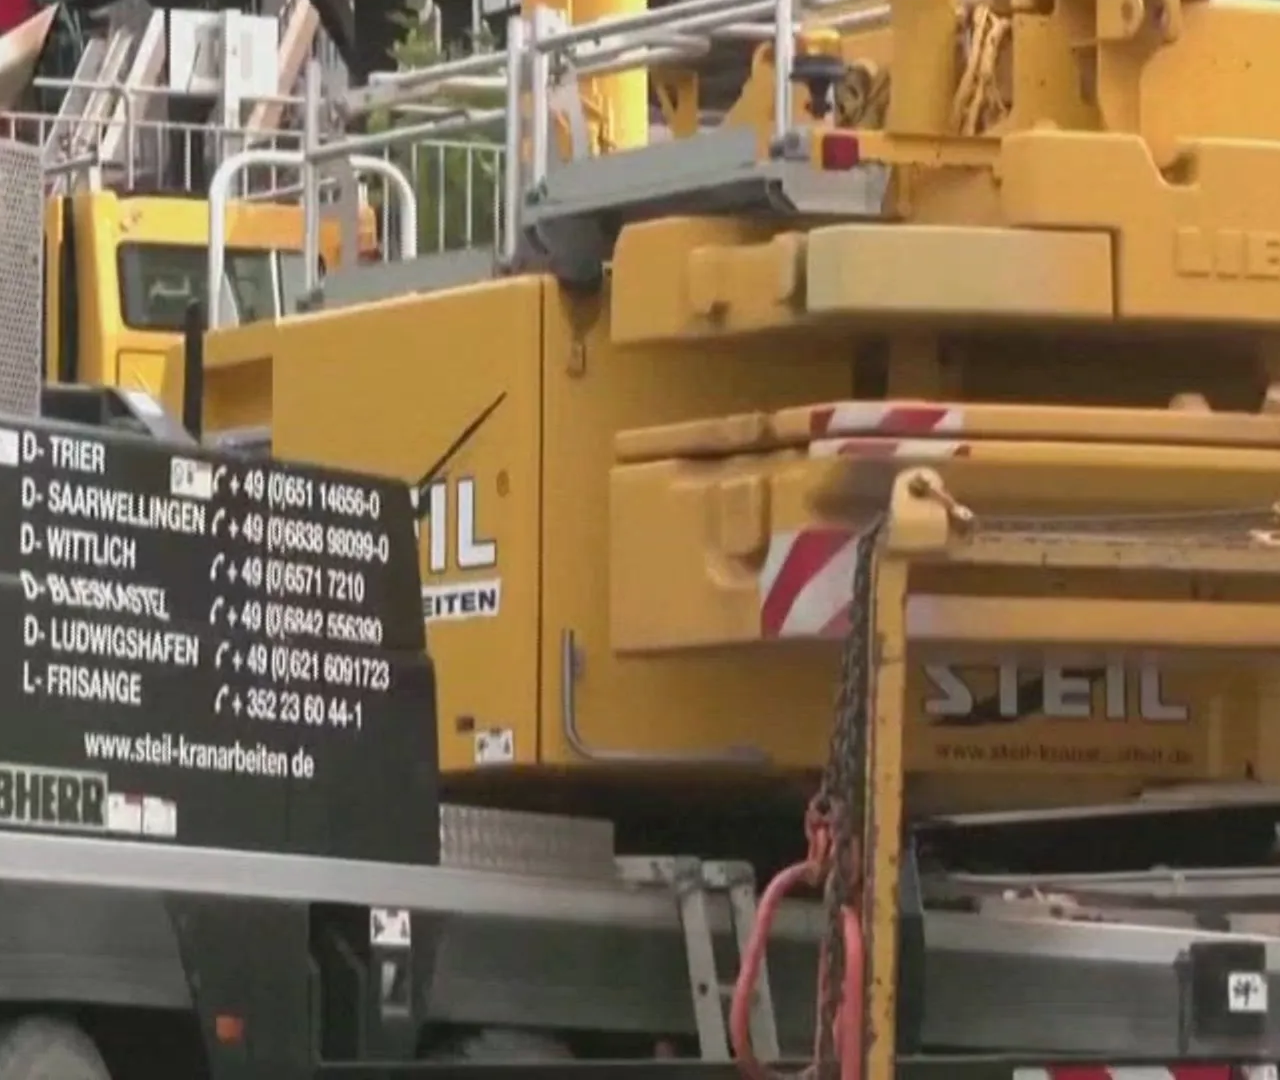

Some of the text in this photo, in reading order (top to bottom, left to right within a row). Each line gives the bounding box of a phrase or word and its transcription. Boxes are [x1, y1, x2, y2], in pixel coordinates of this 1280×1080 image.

[49, 435, 105, 475] TRIER
[48, 480, 206, 535] SAARWELLINGEN
[46, 525, 137, 570] WITTLICH
[327, 568, 365, 603] 7210
[51, 617, 199, 668] LUDWIGSHAFEN
[48, 663, 142, 706] FRISANGE
[323, 652, 390, 692] 6091723
[924, 648, 1190, 721] STEIL
[246, 687, 277, 720] 352
[279, 691, 300, 723] 23
[303, 694, 325, 726] 60
[328, 697, 362, 731] 44-1
[84, 731, 314, 779] www.steil-kranarbeitende
